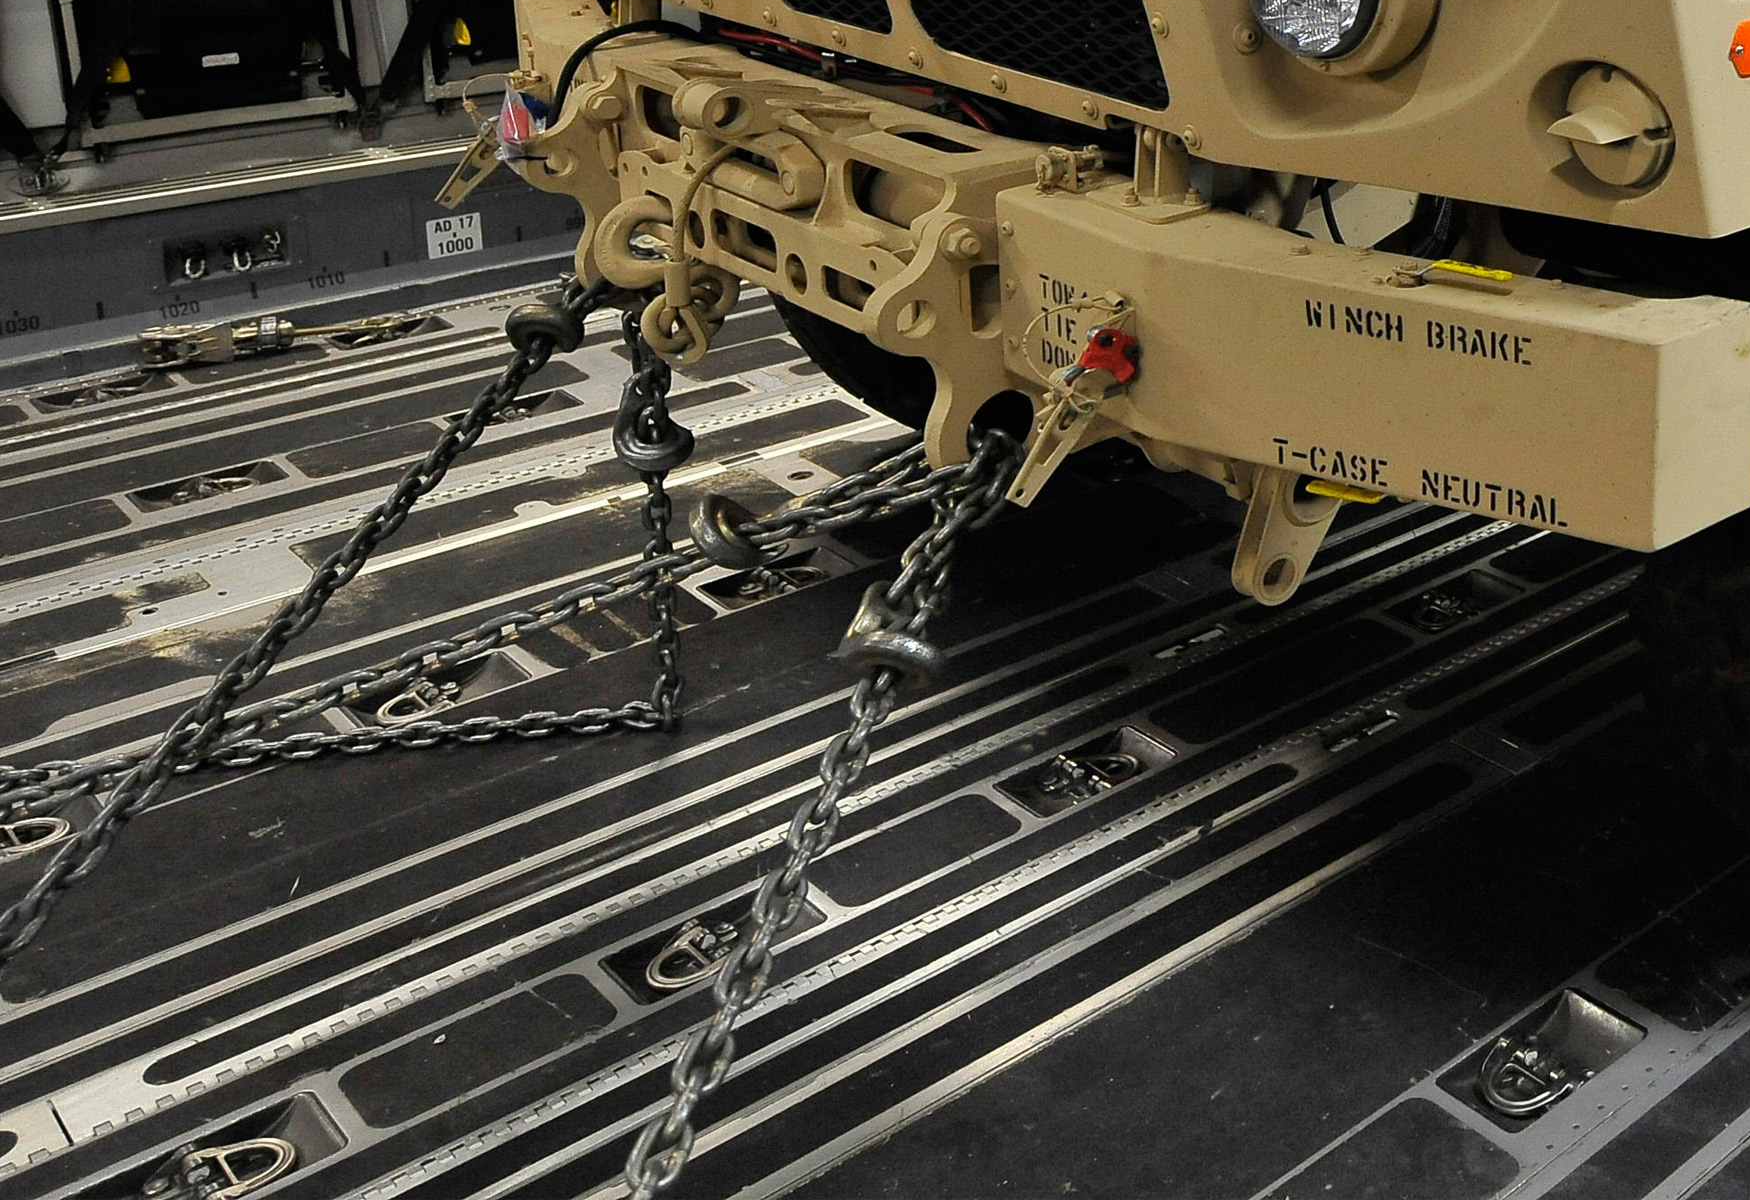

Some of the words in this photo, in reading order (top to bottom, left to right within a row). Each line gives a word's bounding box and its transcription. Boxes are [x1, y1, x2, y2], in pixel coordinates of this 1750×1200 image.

[434, 220, 452, 234] AD
[458, 215, 474, 229] 17
[566, 216, 586, 231] 99
[437, 237, 474, 255] 1000
[308, 271, 346, 289] 1010
[159, 300, 200, 320] 1020
[1041, 306, 1077, 345] TIE
[1305, 299, 1404, 342] WINCH
[1426, 320, 1533, 366] BRAKE
[1272, 437, 1389, 487] T-CASE
[1421, 469, 1569, 528] NEUTRAL
